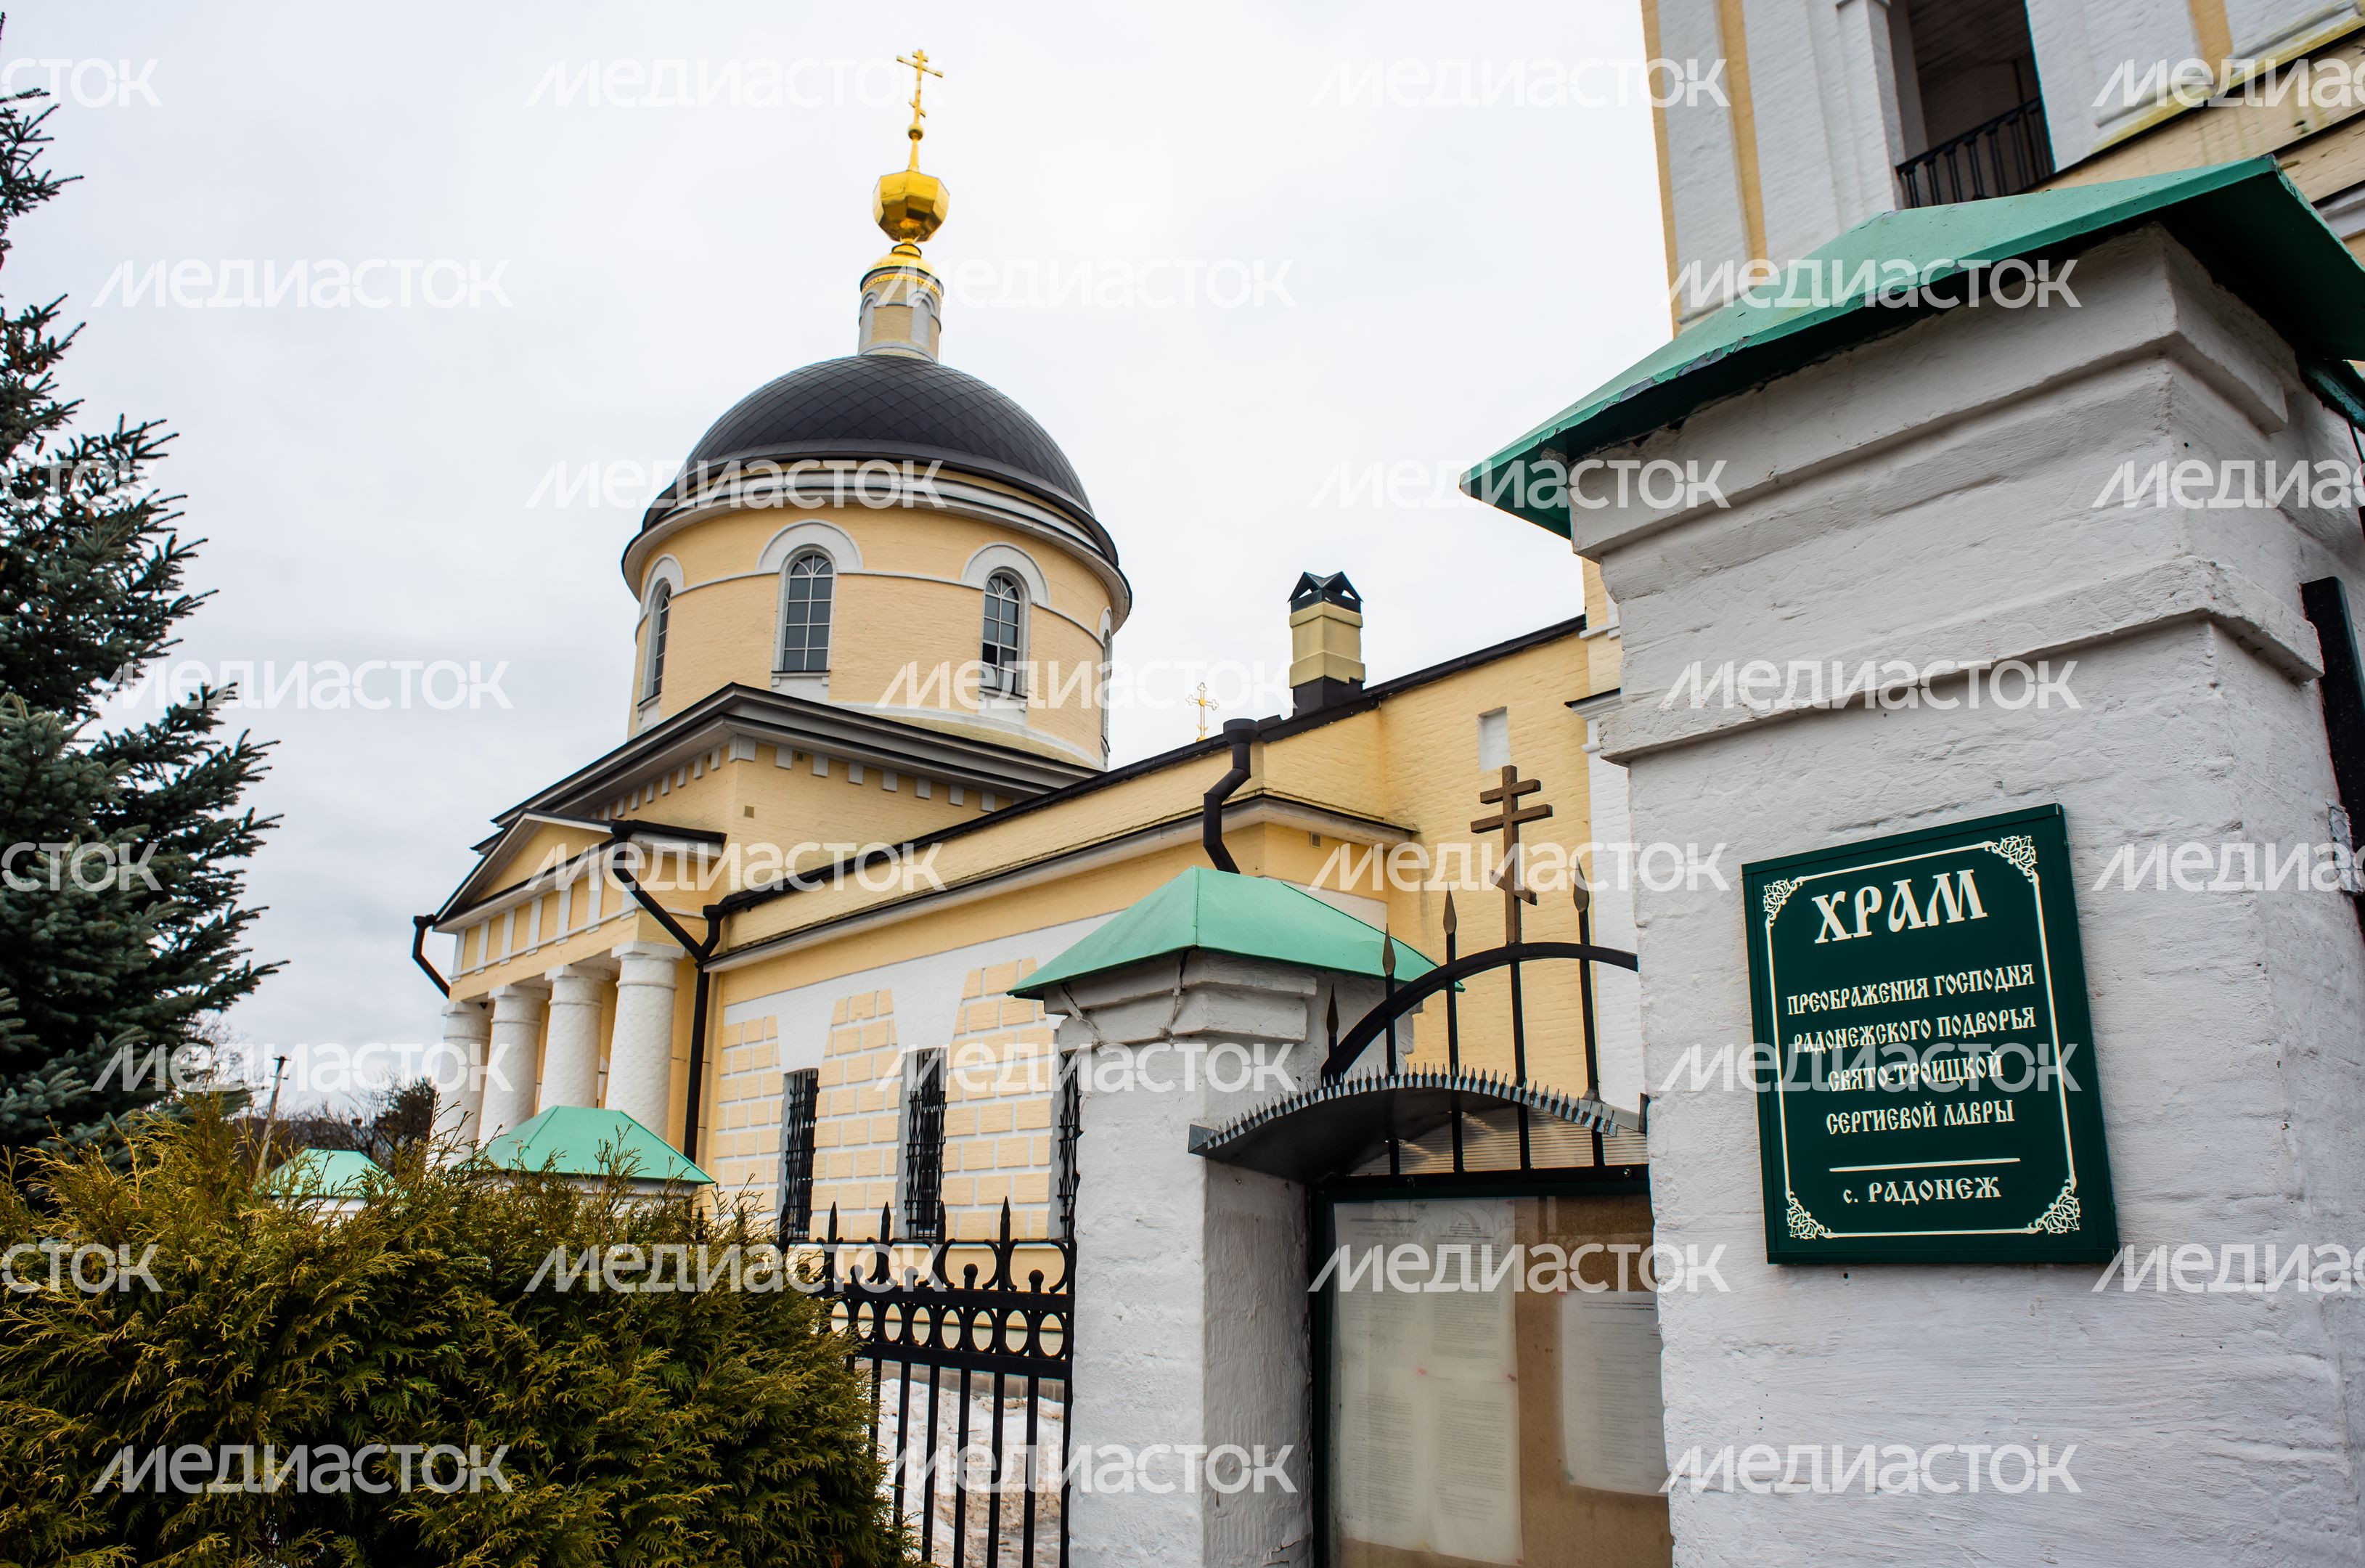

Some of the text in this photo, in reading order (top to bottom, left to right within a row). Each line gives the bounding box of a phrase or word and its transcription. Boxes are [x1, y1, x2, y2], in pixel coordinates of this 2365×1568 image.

[1811, 869, 1988, 944] ХРАМ
[1786, 963, 2035, 1016] ПРЕОБРАЖЕНИЯ ГОСПОДНЯ
[1794, 1007, 2036, 1055] РАДОНЕЖСКОГО ПОДВОРЬЯ
[1828, 1050, 2003, 1092] СВЯТО-ТРОИЦКОЙ
[1826, 1099, 2015, 1135] СЕРГИЕВОЙ ЛАВРЫ
[1842, 1176, 2001, 1206] с. РАДОНЕЖ
